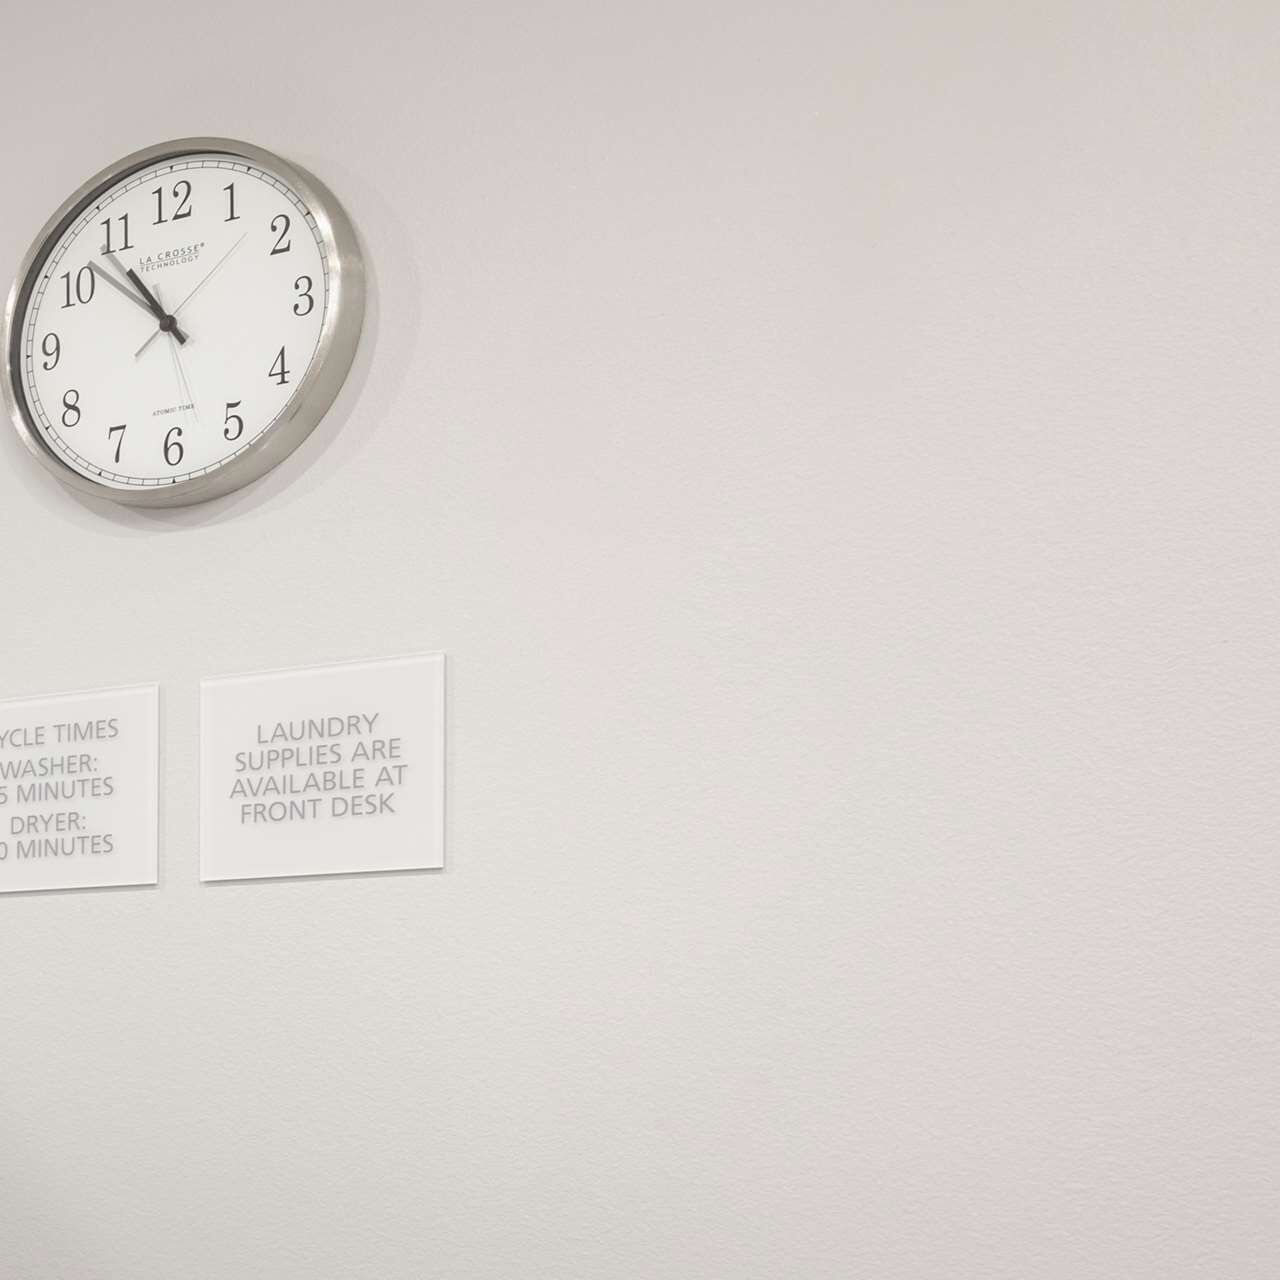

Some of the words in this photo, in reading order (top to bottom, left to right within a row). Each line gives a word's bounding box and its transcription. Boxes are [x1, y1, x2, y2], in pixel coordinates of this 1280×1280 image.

[151, 180, 193, 226] 12
[223, 182, 240, 223] 1
[100, 212, 135, 256] 11
[269, 213, 292, 256] 2
[139, 256, 153, 265] LA
[139, 255, 199, 272] TECHNOLOGY
[60, 265, 96, 309] 10
[292, 275, 315, 317] 3
[41, 332, 61, 371] 9
[267, 345, 291, 386] 4
[61, 389, 82, 428] 8
[222, 400, 244, 441] 5
[107, 423, 127, 464] 7
[162, 426, 185, 466] 6
[52, 718, 120, 744] TIMES
[256, 712, 380, 744] LAUNDRY
[0, 754, 98, 780] WASHER:
[235, 743, 342, 773] SUPPLIES
[351, 738, 401, 762] ARE
[16, 776, 115, 804] MINUTES
[229, 768, 365, 799] AVAILABLE
[374, 764, 409, 787] AT
[10, 811, 87, 835] DRYER:
[240, 798, 323, 825] FRONT
[331, 792, 396, 818] DESK
[16, 833, 114, 860] MINUTES
